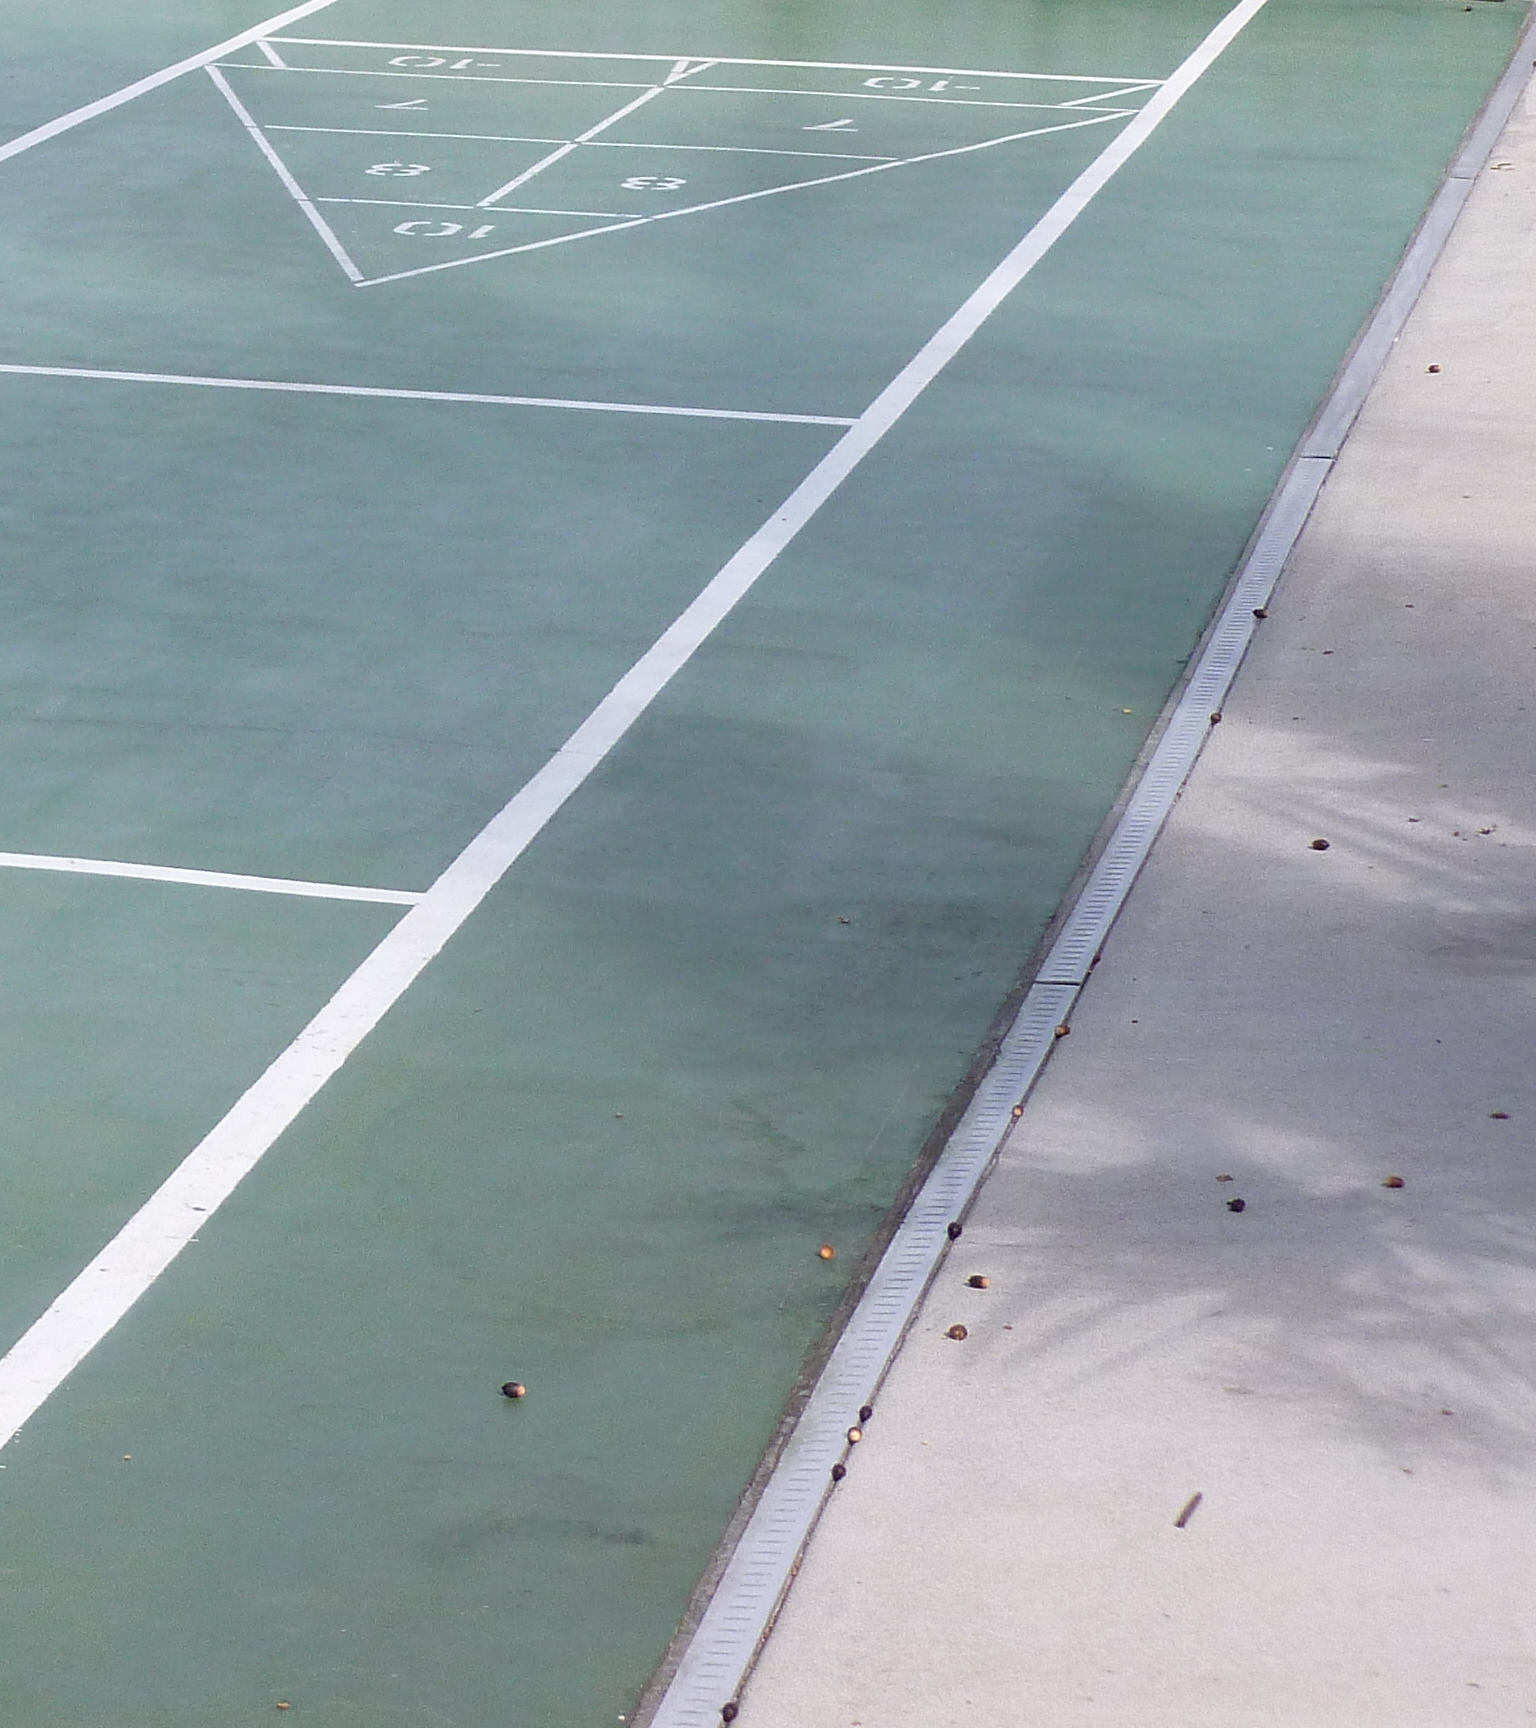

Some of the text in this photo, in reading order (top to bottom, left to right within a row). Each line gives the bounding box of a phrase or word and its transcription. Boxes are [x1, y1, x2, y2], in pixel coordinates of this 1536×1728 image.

[373, 99, 429, 111] 7
[801, 119, 860, 133] 7
[364, 163, 431, 177] 8
[619, 175, 687, 191] 8
[393, 221, 497, 239] 10
